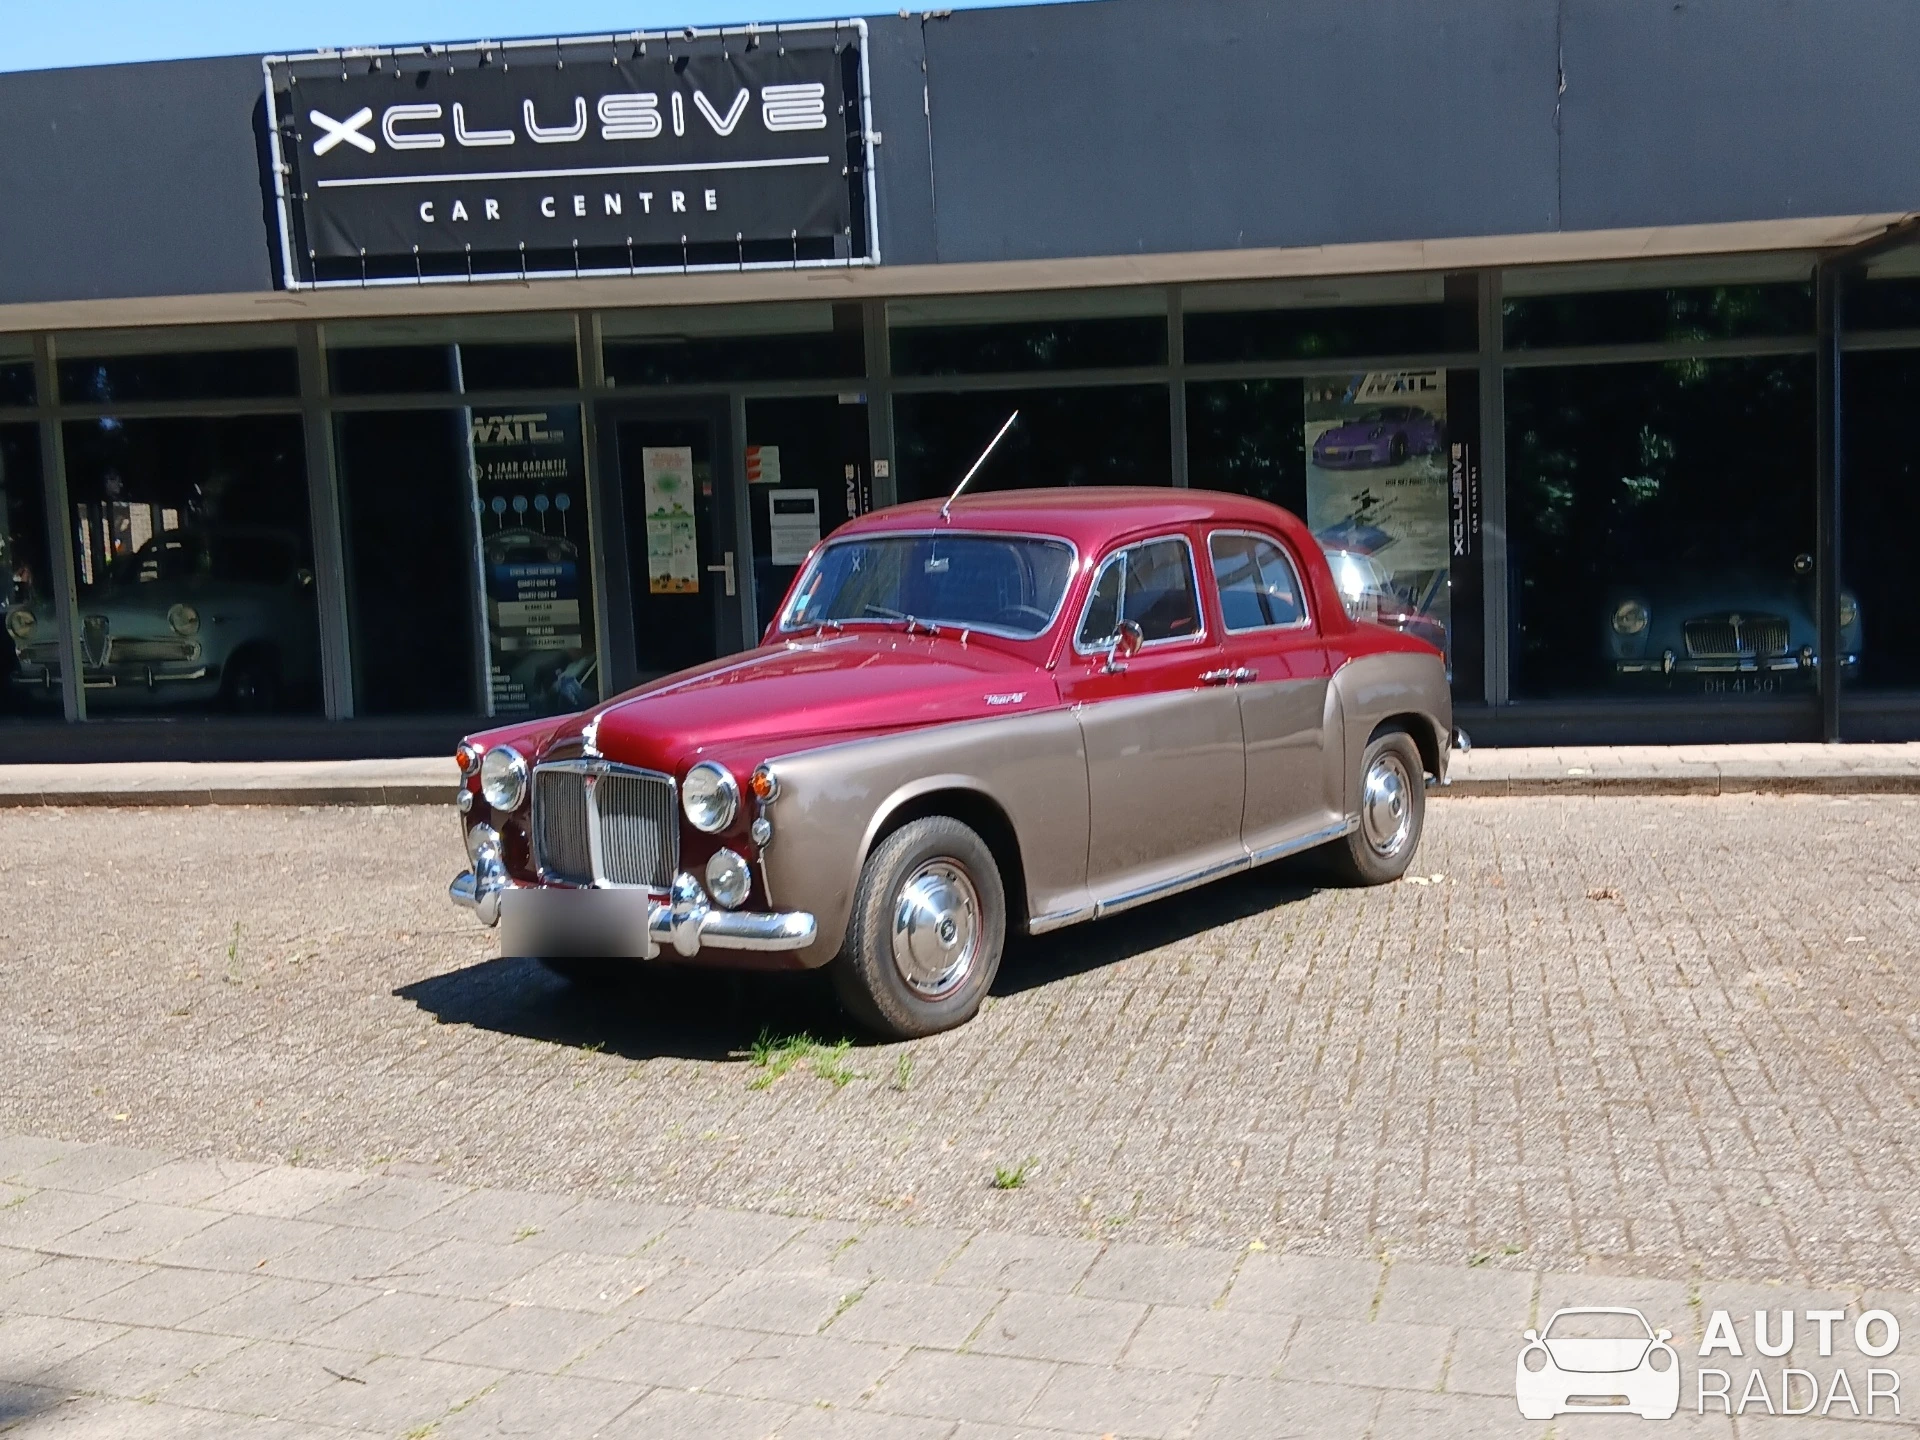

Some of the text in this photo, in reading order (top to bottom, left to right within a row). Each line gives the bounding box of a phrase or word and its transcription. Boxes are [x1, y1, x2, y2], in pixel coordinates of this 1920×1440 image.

[309, 82, 827, 156] XCLUSIVE
[419, 188, 718, 223] CAR CENTRE
[497, 461, 518, 473] JAAR
[522, 458, 566, 472] GARANTIE
[1451, 442, 1464, 556] XCLUSIVE
